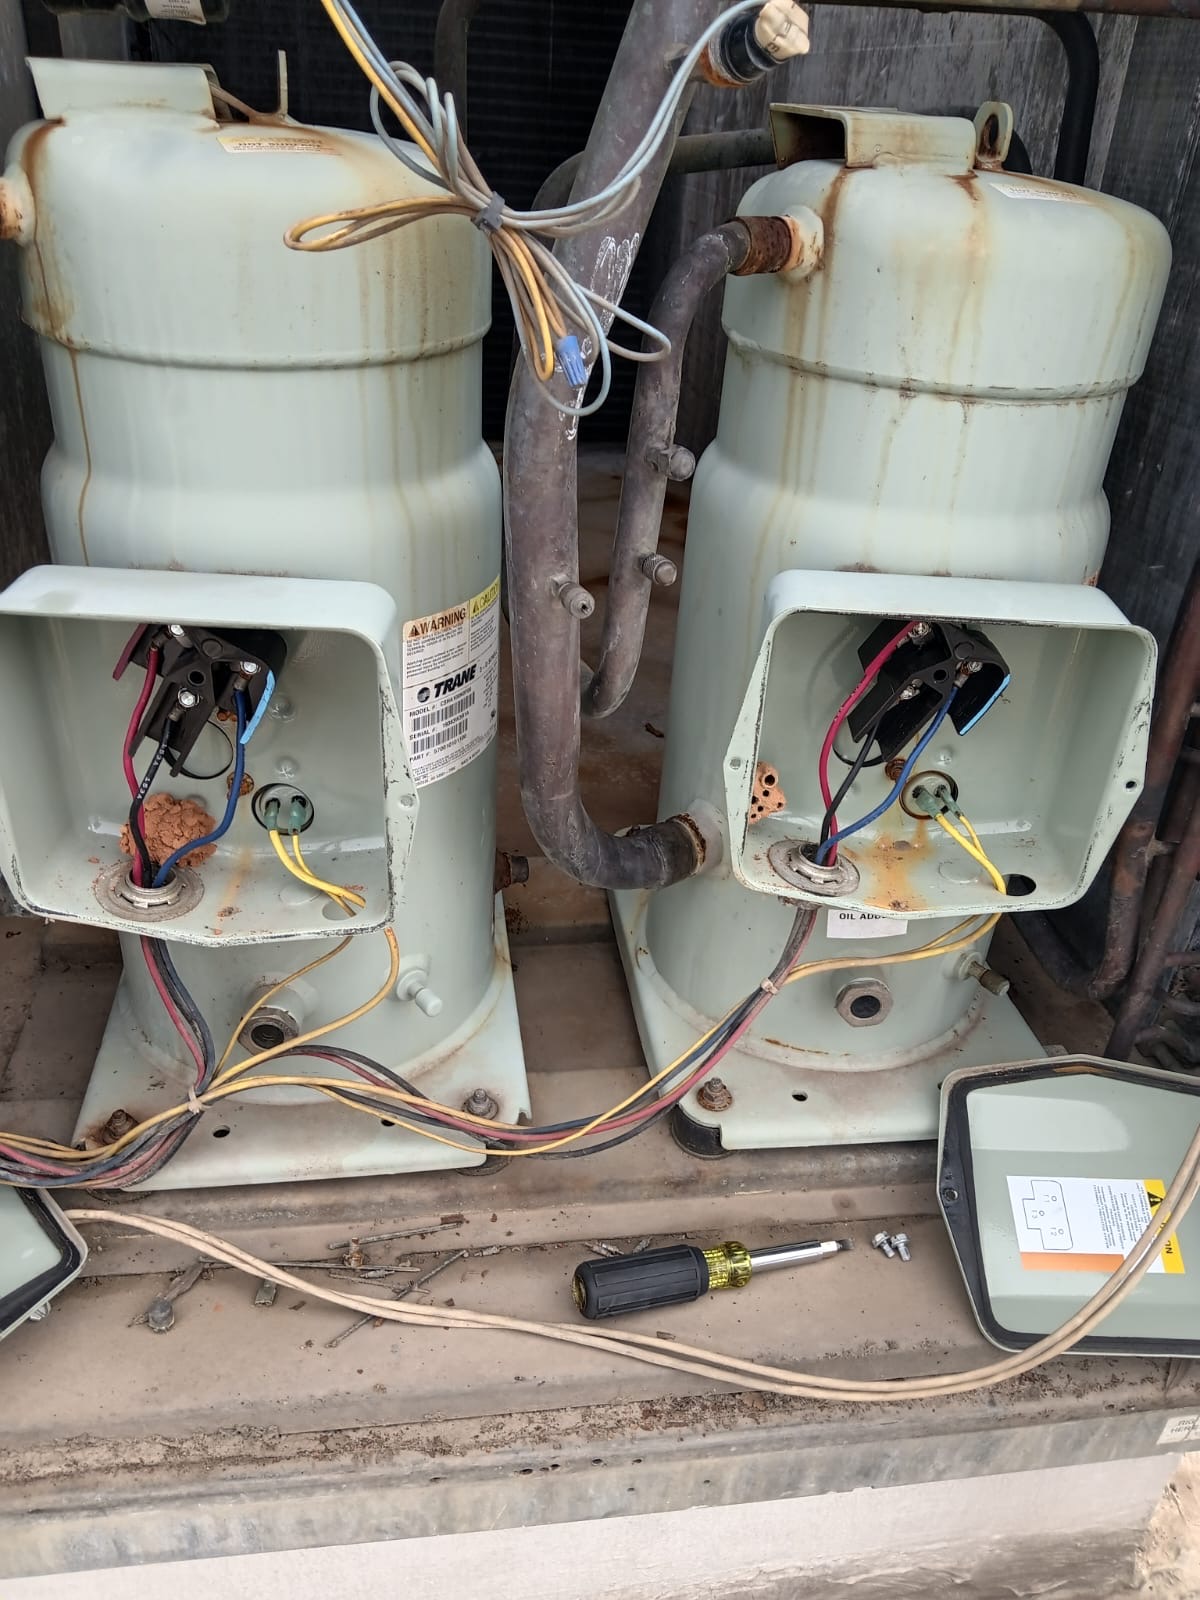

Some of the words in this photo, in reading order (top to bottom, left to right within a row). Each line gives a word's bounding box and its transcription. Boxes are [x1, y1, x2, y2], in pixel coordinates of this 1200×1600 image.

[420, 607, 466, 634] WARNING
[434, 664, 476, 698] TRANE
[409, 706, 430, 717] MODEL
